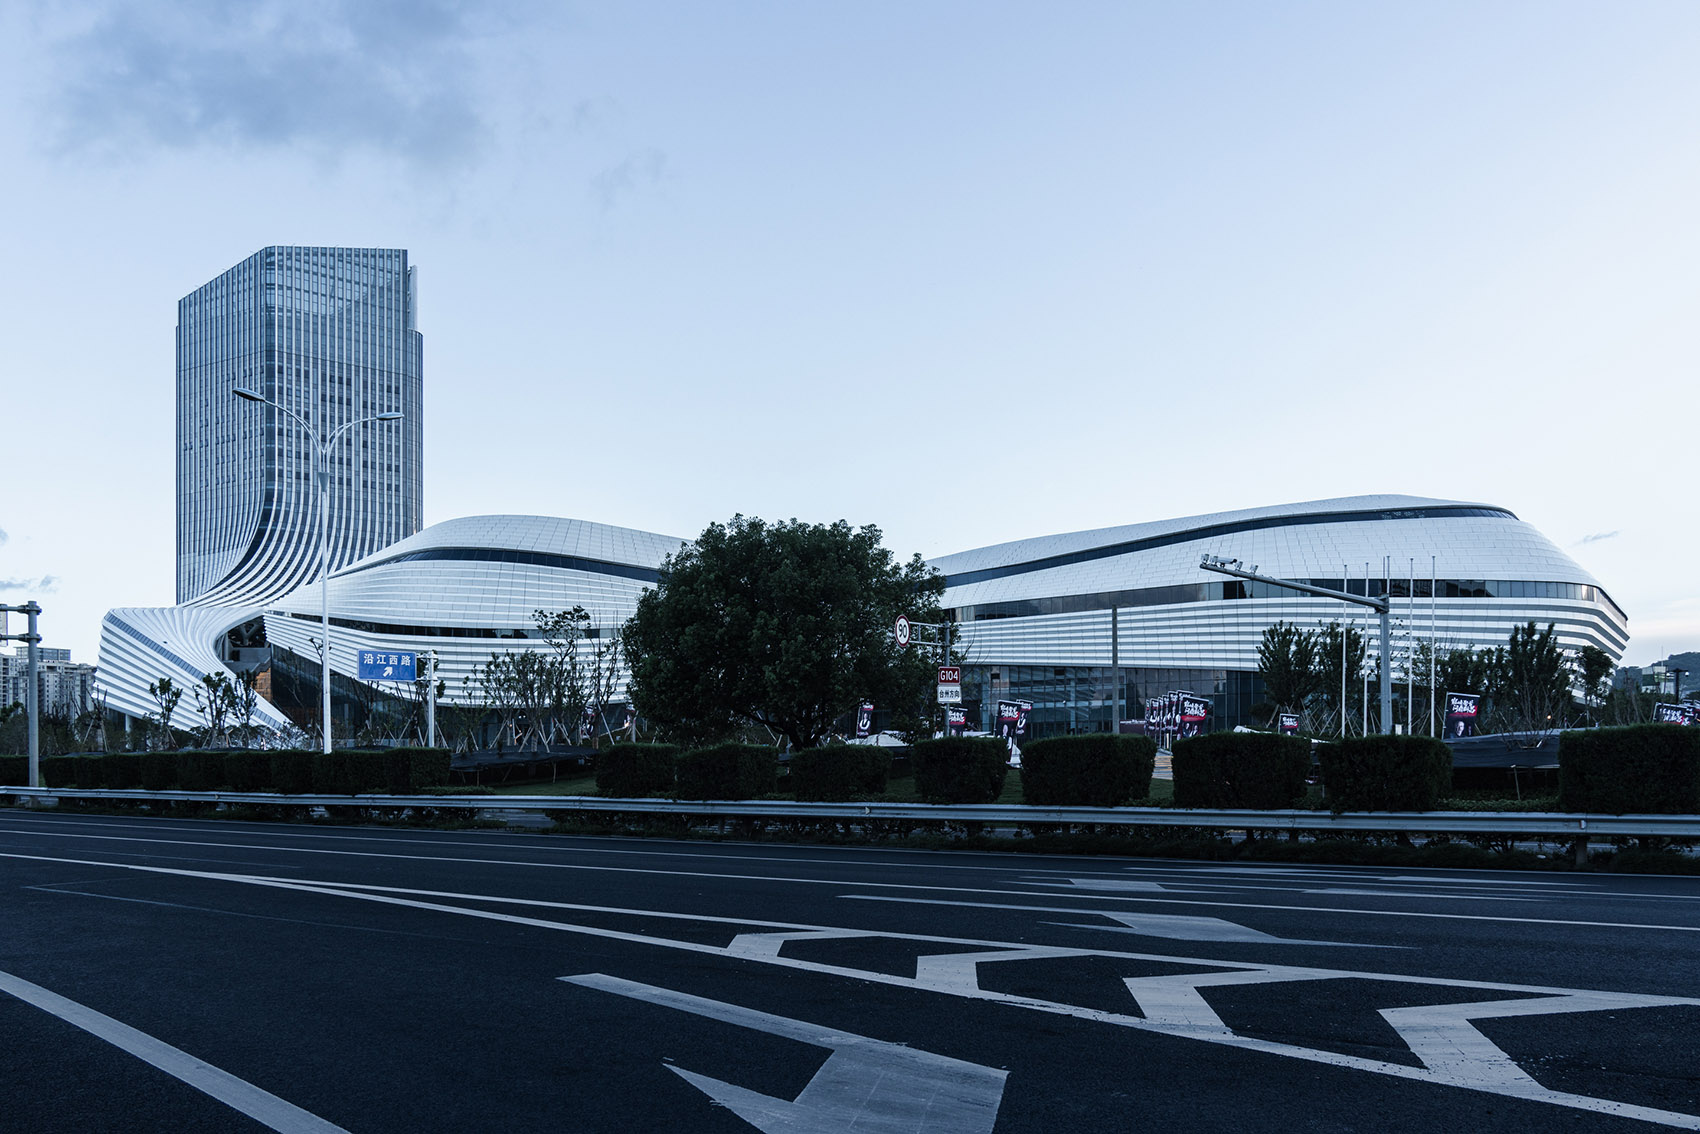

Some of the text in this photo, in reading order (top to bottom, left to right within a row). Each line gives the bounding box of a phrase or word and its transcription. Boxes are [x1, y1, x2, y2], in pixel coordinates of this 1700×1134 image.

[899, 624, 907, 638] 90
[364, 653, 411, 666] 沿江西路
[940, 670, 958, 680] G104
[939, 690, 959, 698] 台州方向
